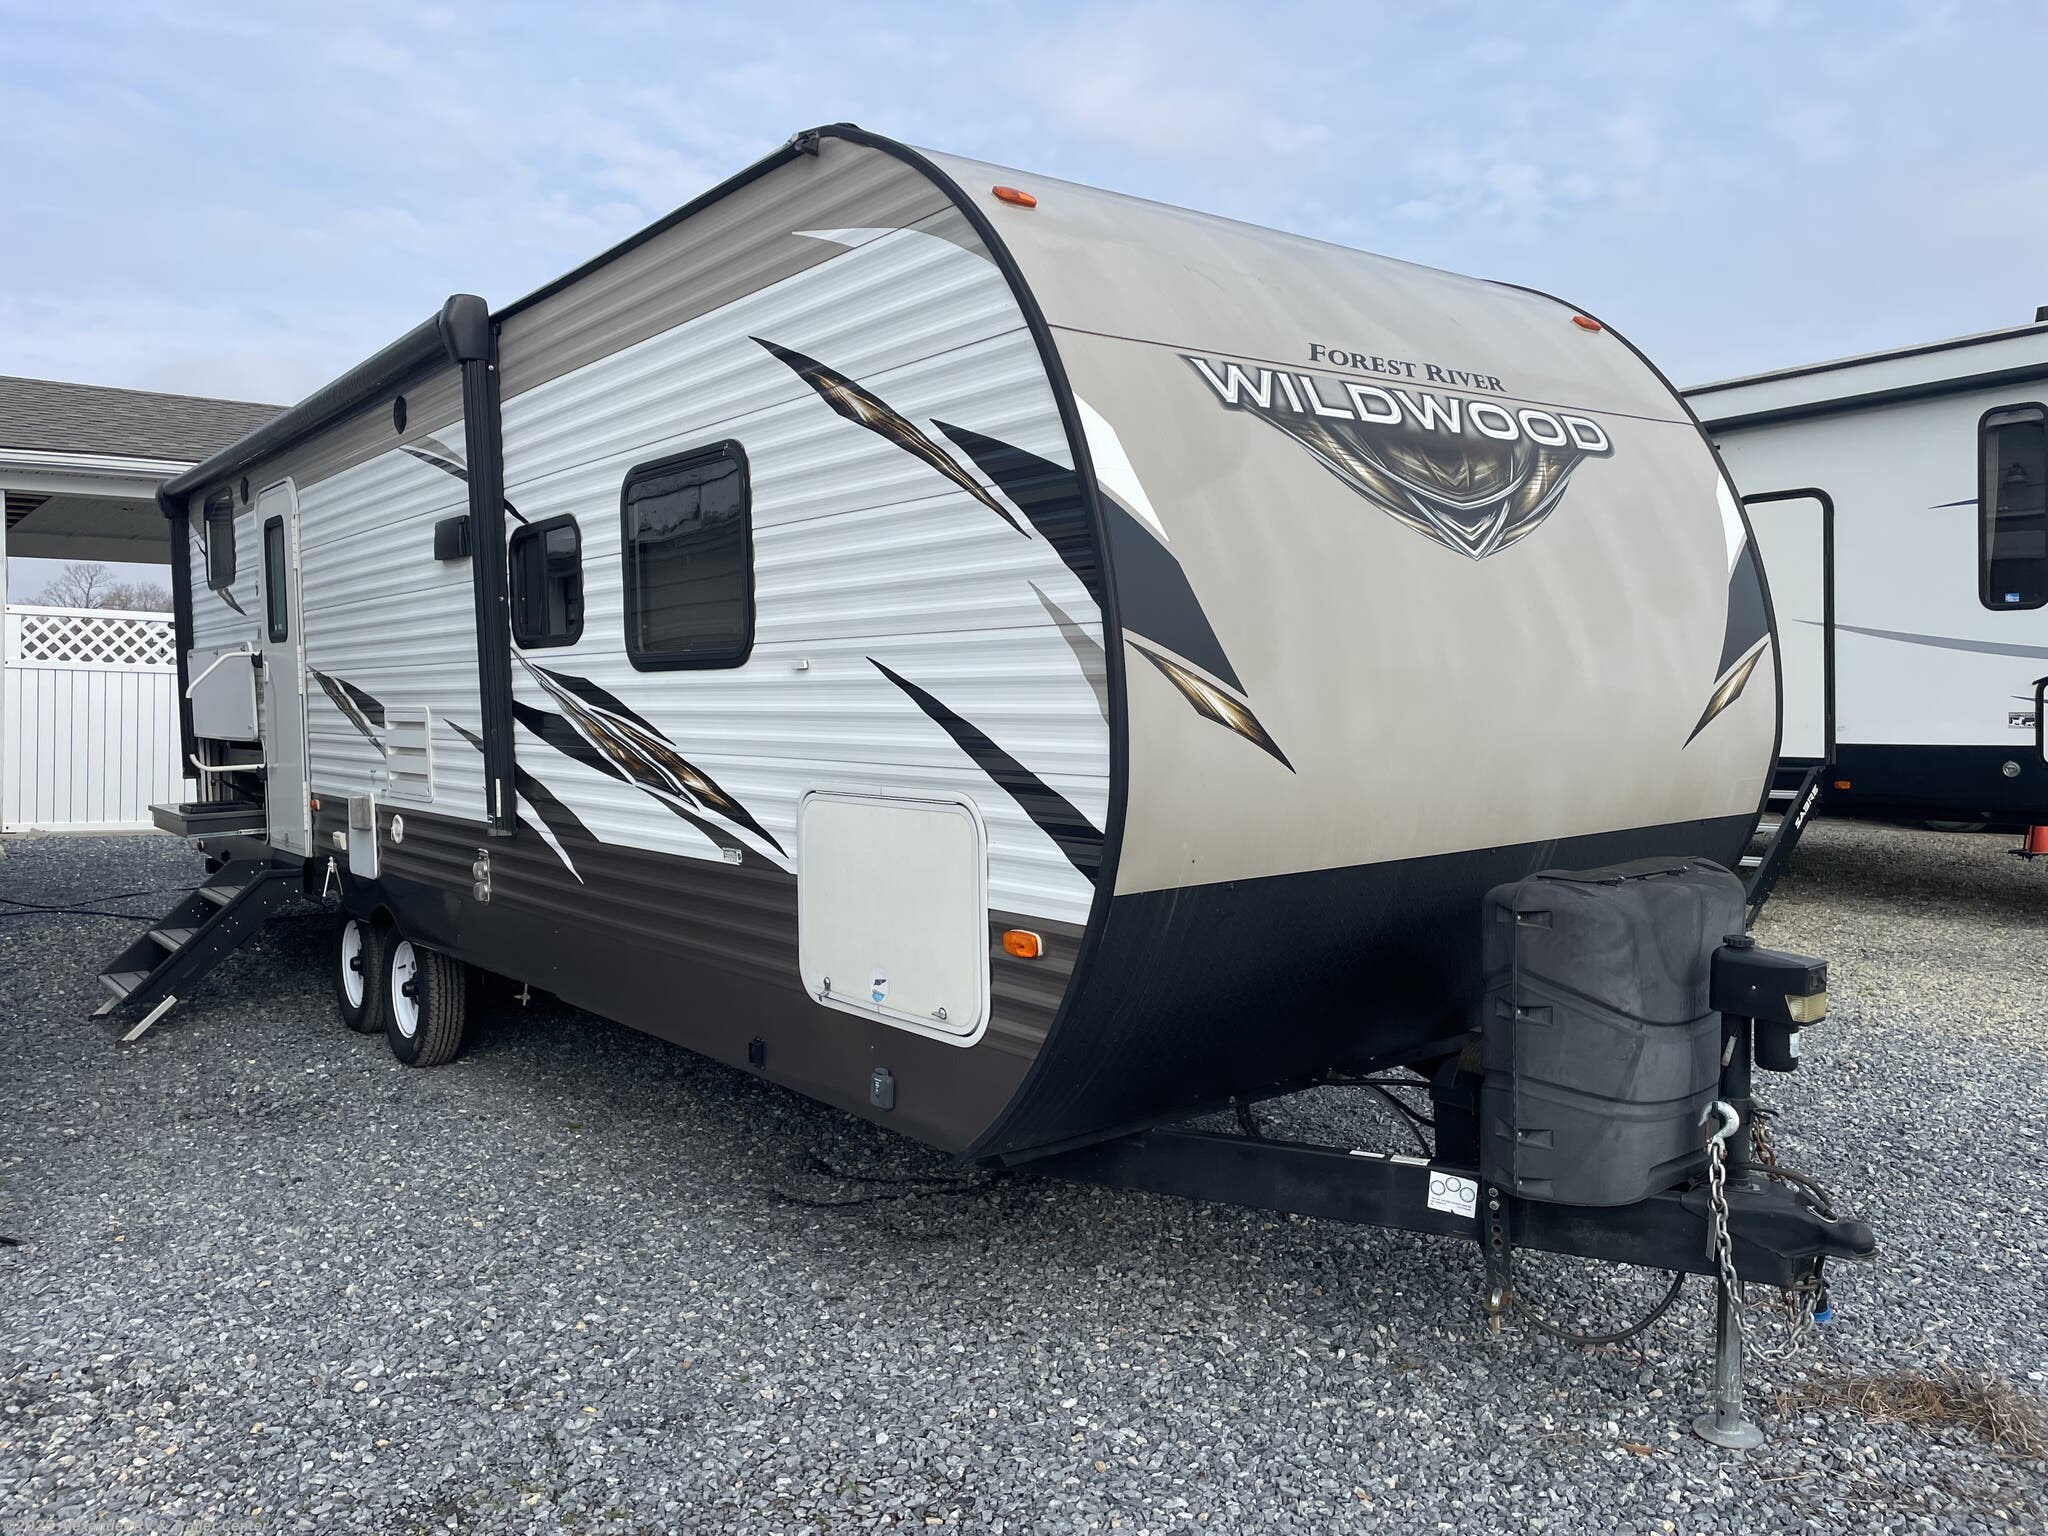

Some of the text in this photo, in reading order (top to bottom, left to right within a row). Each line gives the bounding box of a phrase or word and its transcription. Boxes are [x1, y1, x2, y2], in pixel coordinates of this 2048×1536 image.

[1187, 355, 1611, 453] WILDWOOD
[1308, 342, 1507, 392] FOREST RIVER
